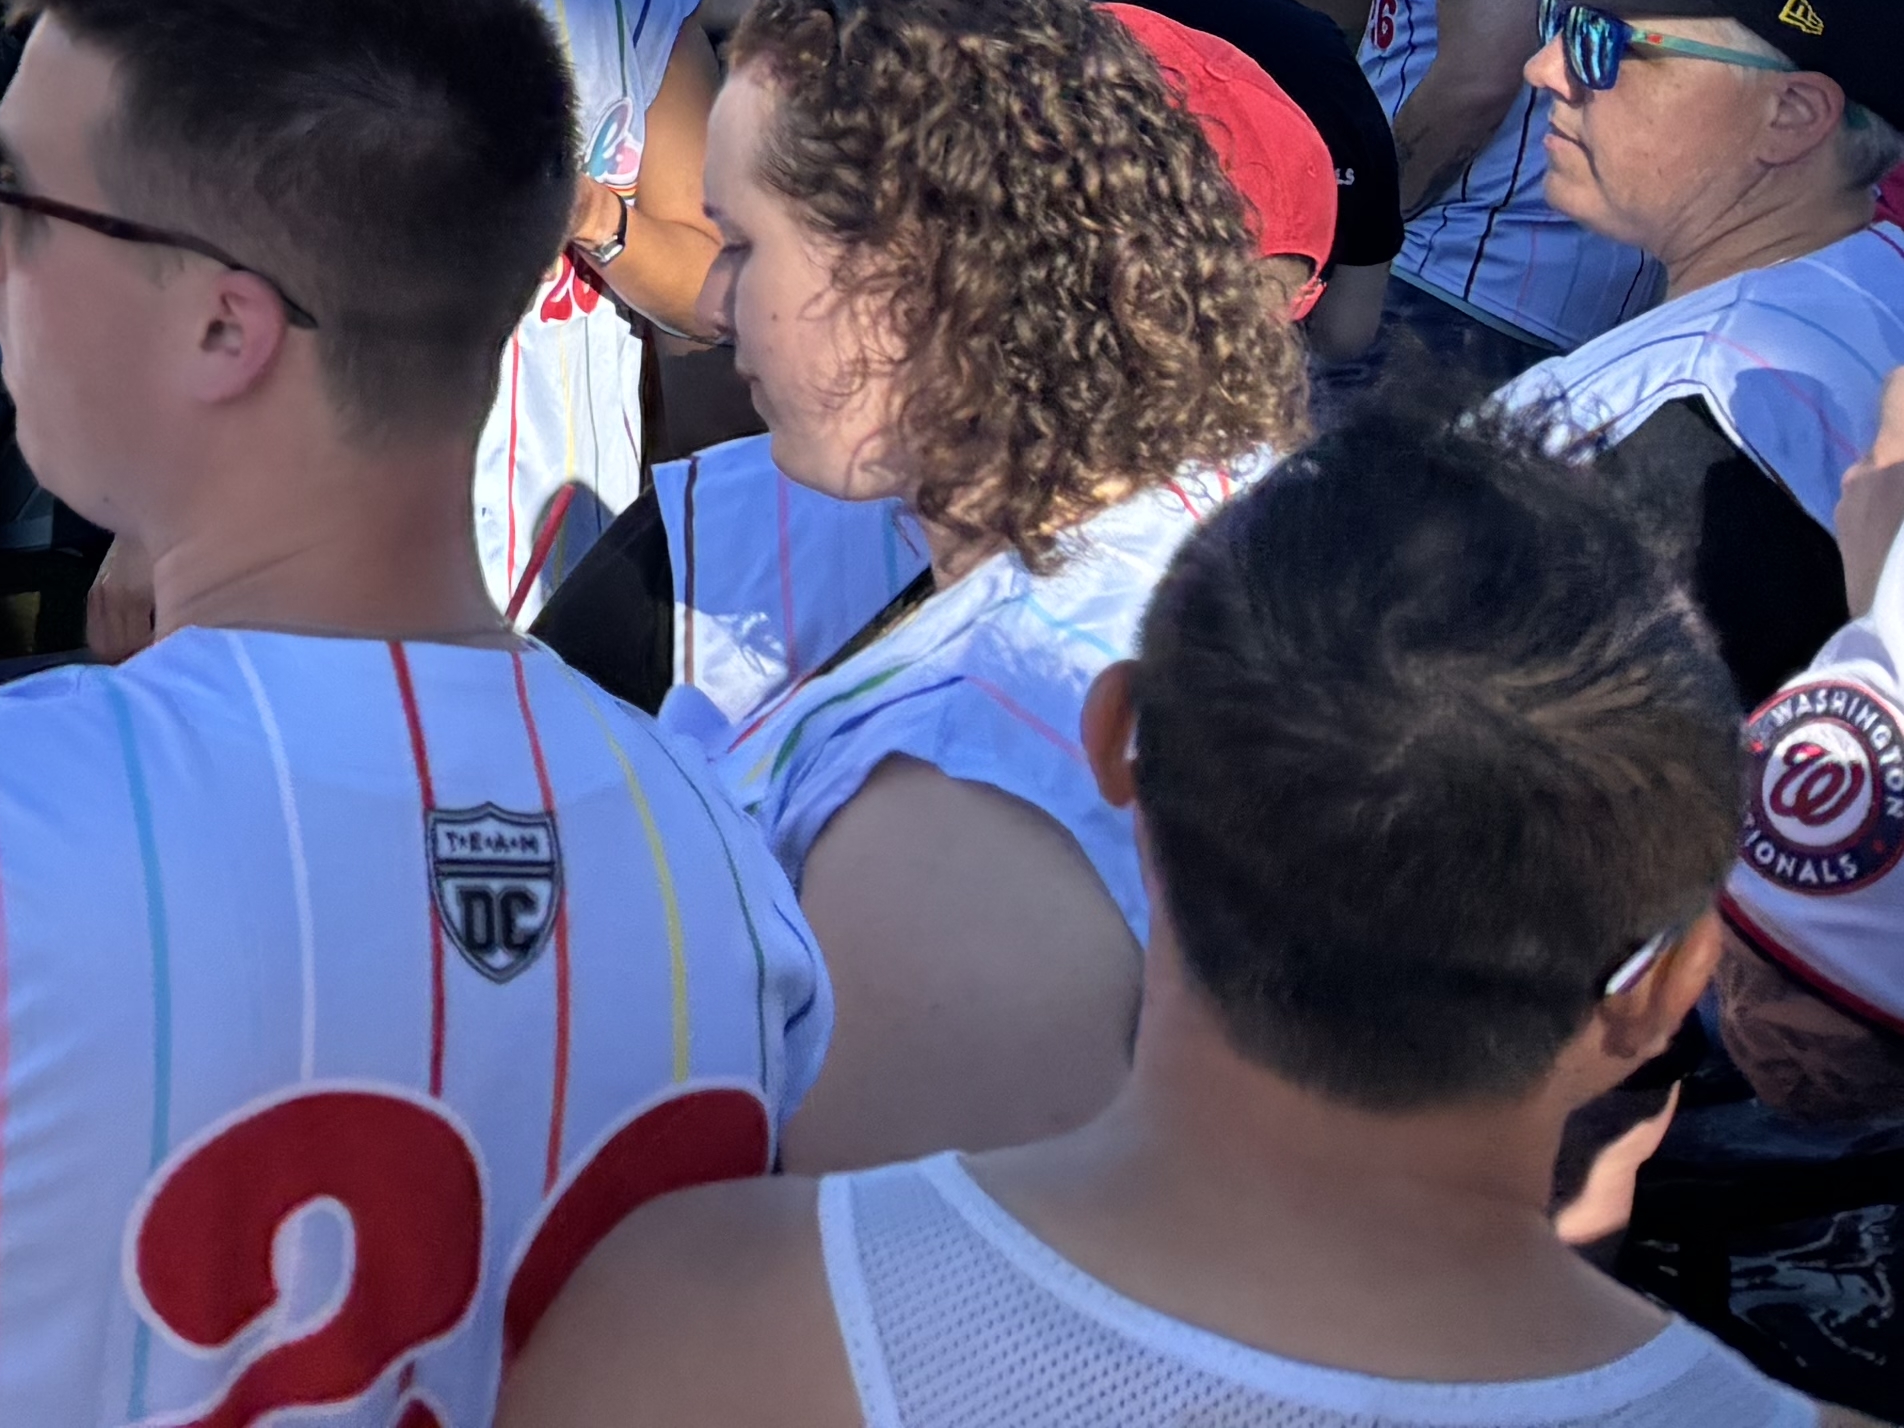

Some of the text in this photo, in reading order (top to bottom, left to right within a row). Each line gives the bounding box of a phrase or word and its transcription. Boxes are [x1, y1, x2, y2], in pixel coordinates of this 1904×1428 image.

[1769, 742, 1866, 827] W
[1770, 688, 1904, 819] WASHINGTON
[1743, 814, 1858, 885] IONALS
[455, 884, 542, 955] DC
